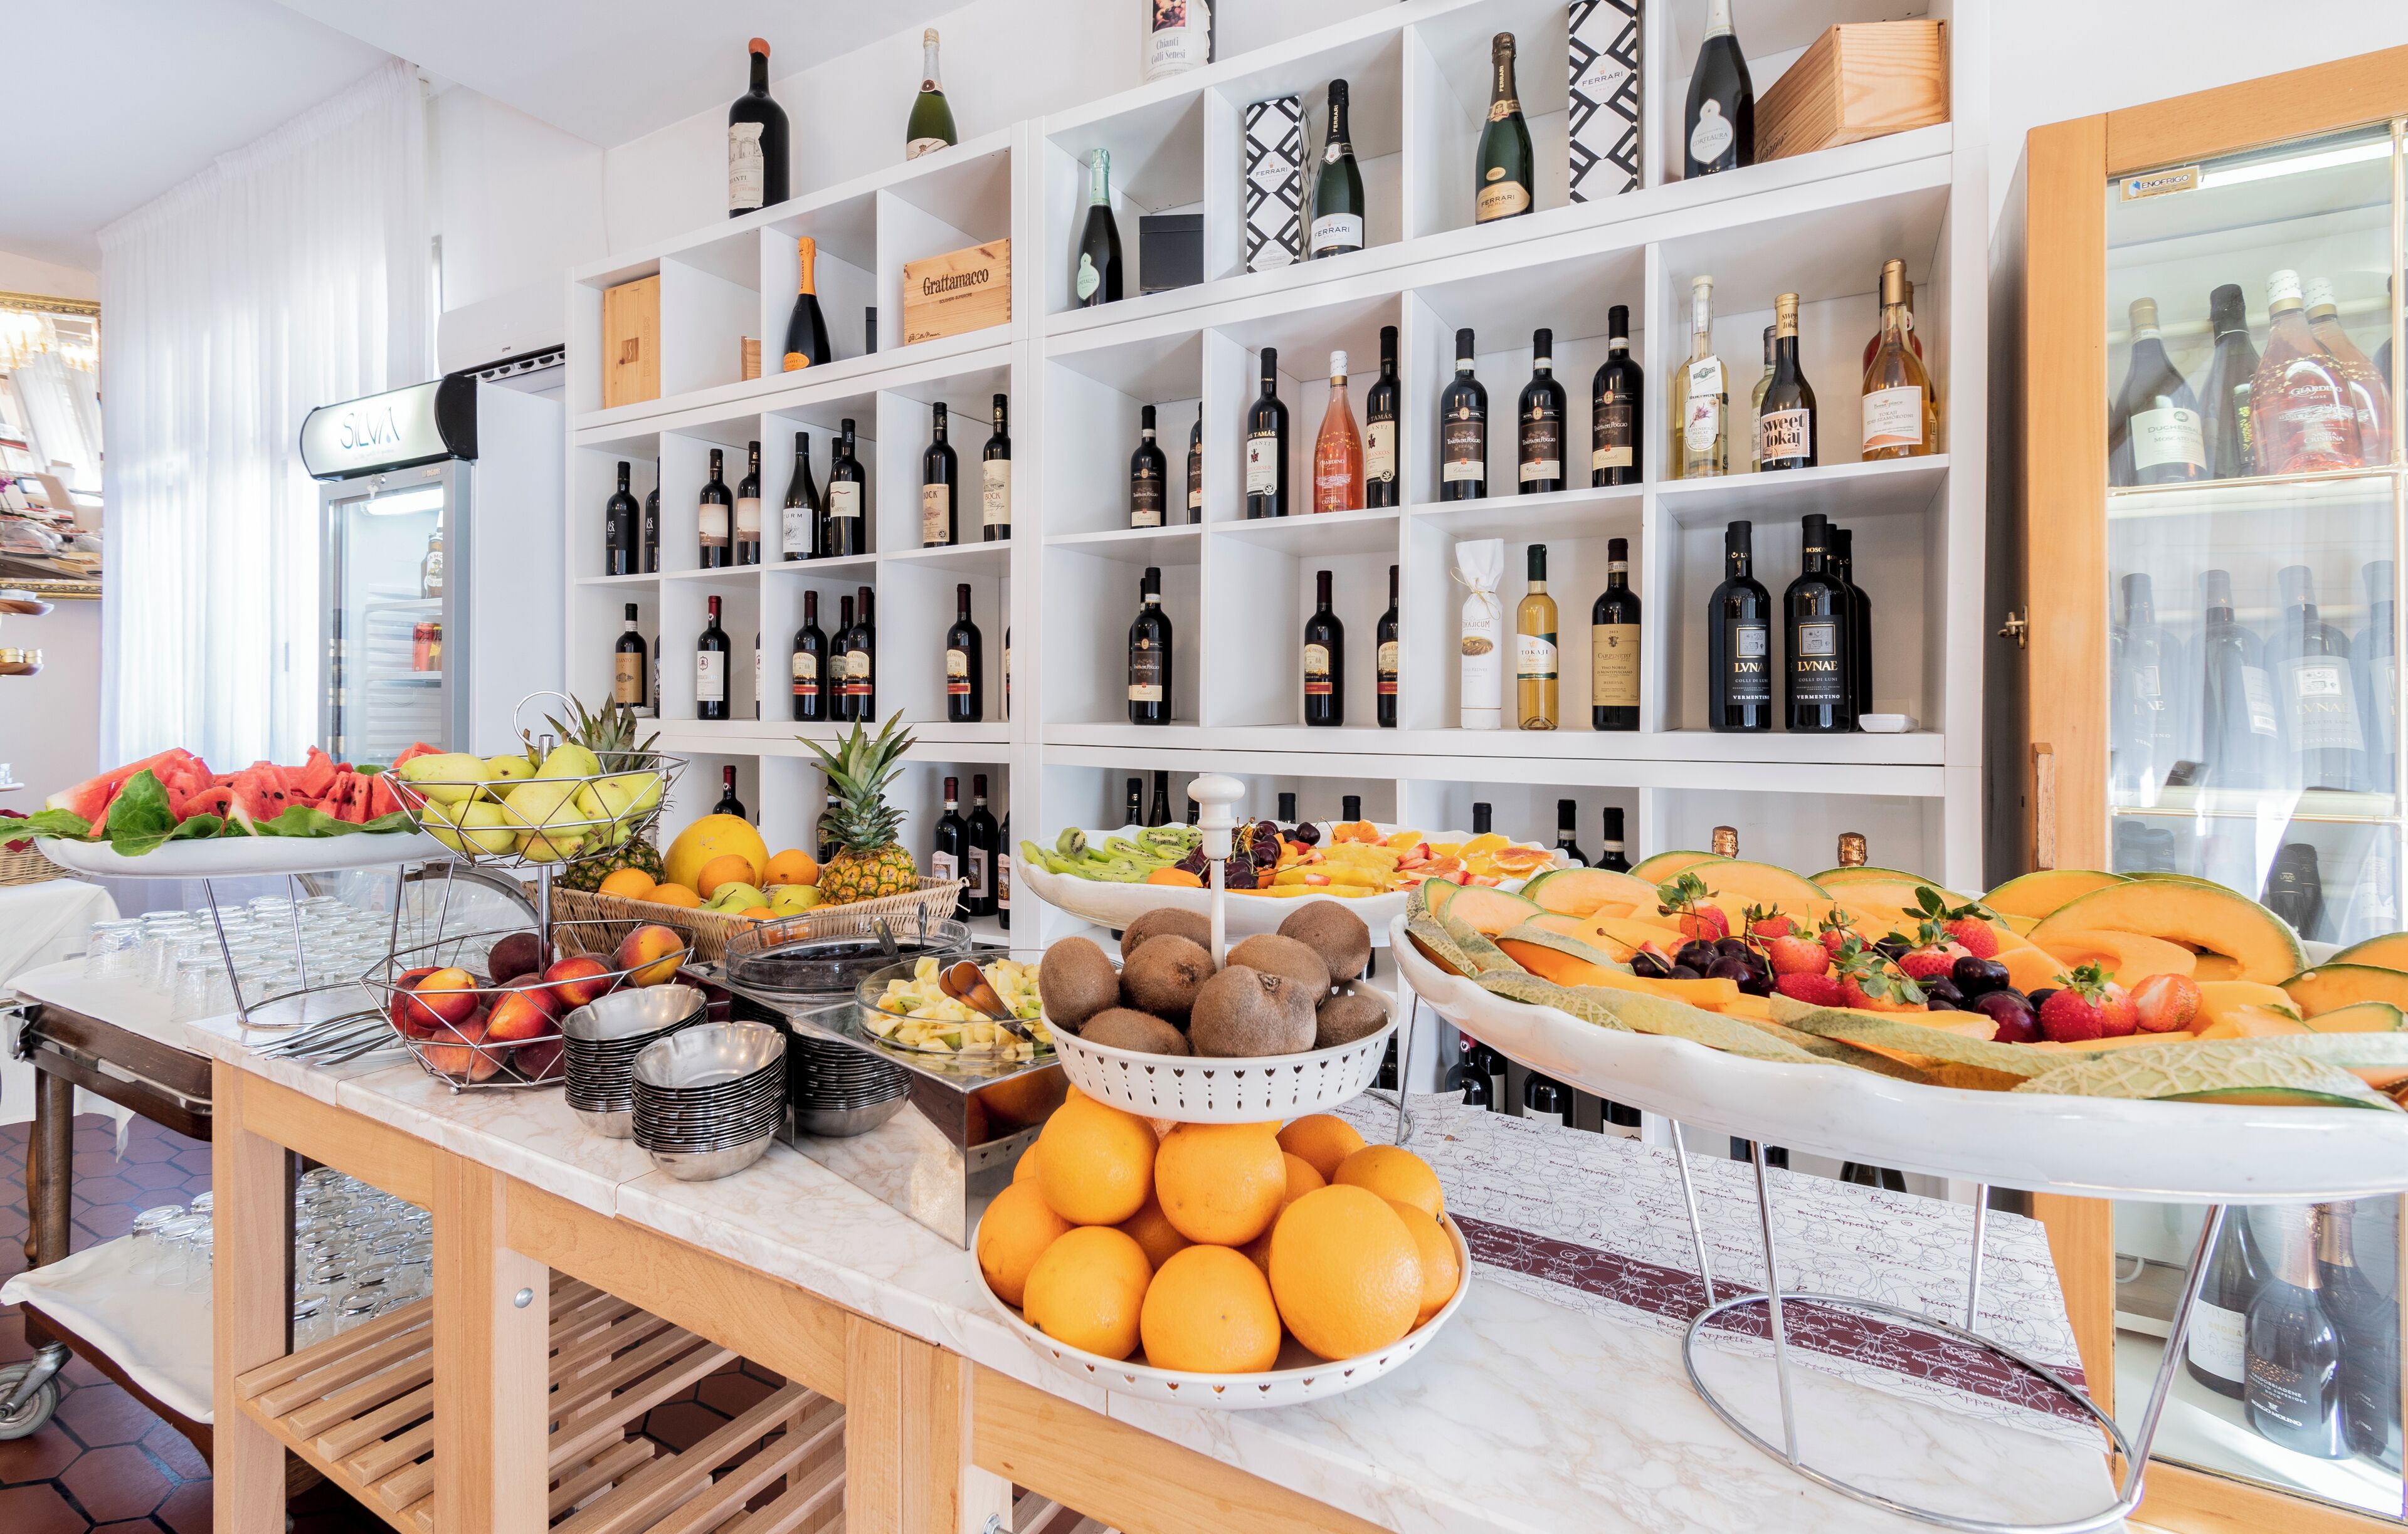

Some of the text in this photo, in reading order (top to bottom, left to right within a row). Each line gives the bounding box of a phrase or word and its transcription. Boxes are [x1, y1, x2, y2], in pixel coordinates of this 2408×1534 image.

[1156, 36, 1179, 50] Chianti
[1151, 50, 1186, 65] Colli Senesi
[1582, 70, 1624, 87] FERRARI
[1256, 167, 1288, 177] FERRARI
[2141, 175, 2189, 189] ENOFRIGO
[1481, 194, 1515, 208] FERRARI
[1314, 226, 1351, 239] FERRARI
[922, 268, 989, 296] Grattamacco
[341, 407, 400, 449] SILVA
[1763, 413, 1805, 434] sweet
[1766, 428, 1801, 447] tokaj
[2304, 435, 2345, 444] CRISTINA
[985, 492, 1001, 500] BOCK
[1734, 663, 1765, 673] LVNA
[1797, 661, 1839, 672] LVNAE
[1835, 1218, 1882, 1231] Appetito
[1713, 1242, 1760, 1258] Appetito
[1657, 1318, 1753, 1343] Buo Appetito
[2251, 1372, 2302, 1399] VALDOBBIADENE
[1901, 1378, 2020, 1416] Buon Appetito
[2273, 1389, 2308, 1404] SUPERIORE
[2270, 1411, 2303, 1426] MOLINO
